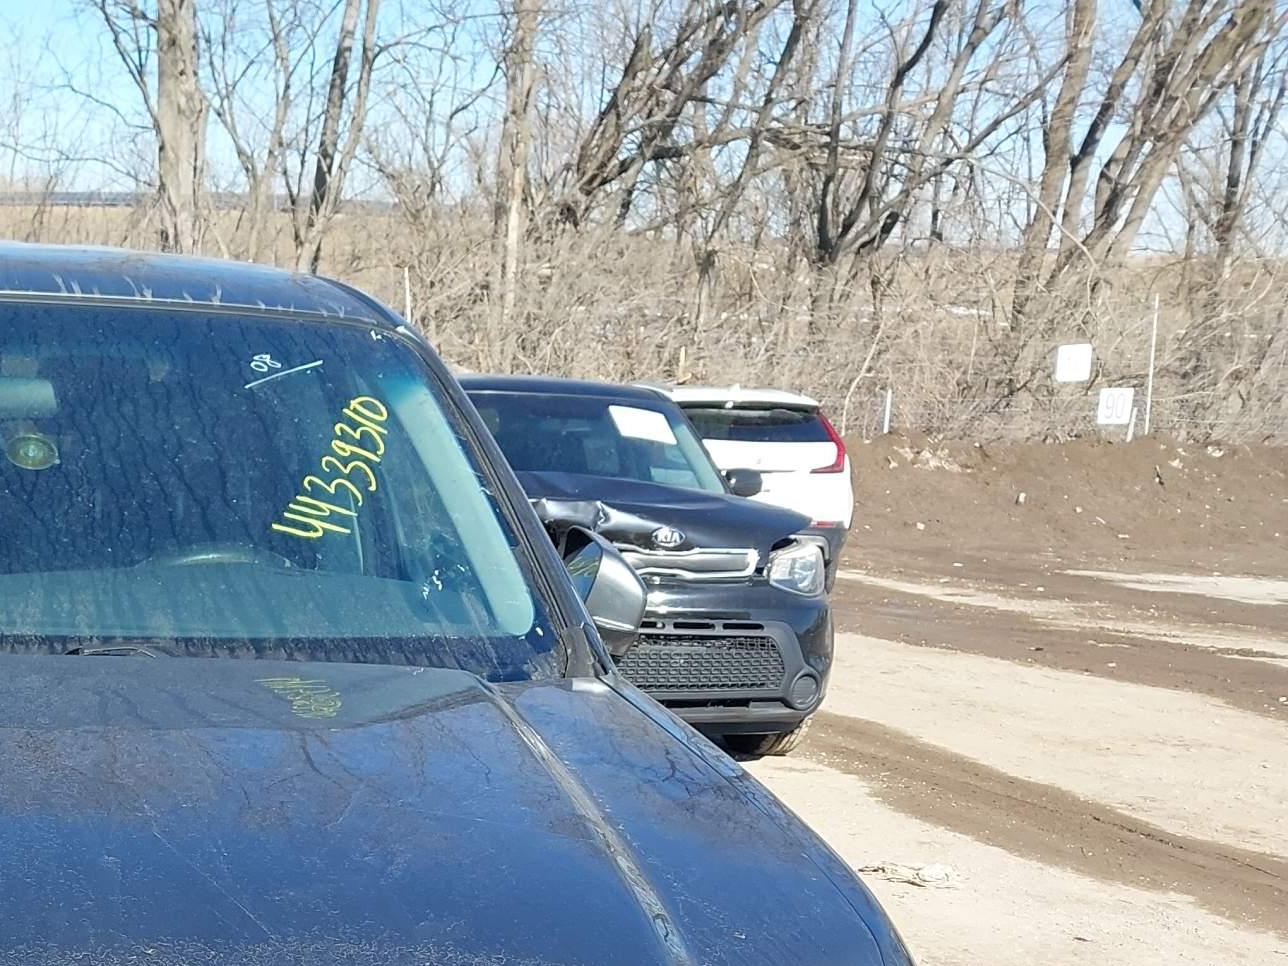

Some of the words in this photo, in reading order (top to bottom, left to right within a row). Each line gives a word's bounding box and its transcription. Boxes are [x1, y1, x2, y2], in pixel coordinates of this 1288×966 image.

[250, 354, 282, 372] 08
[1104, 392, 1126, 419] 90
[271, 396, 388, 538] 44339310
[656, 529, 681, 543] KIA
